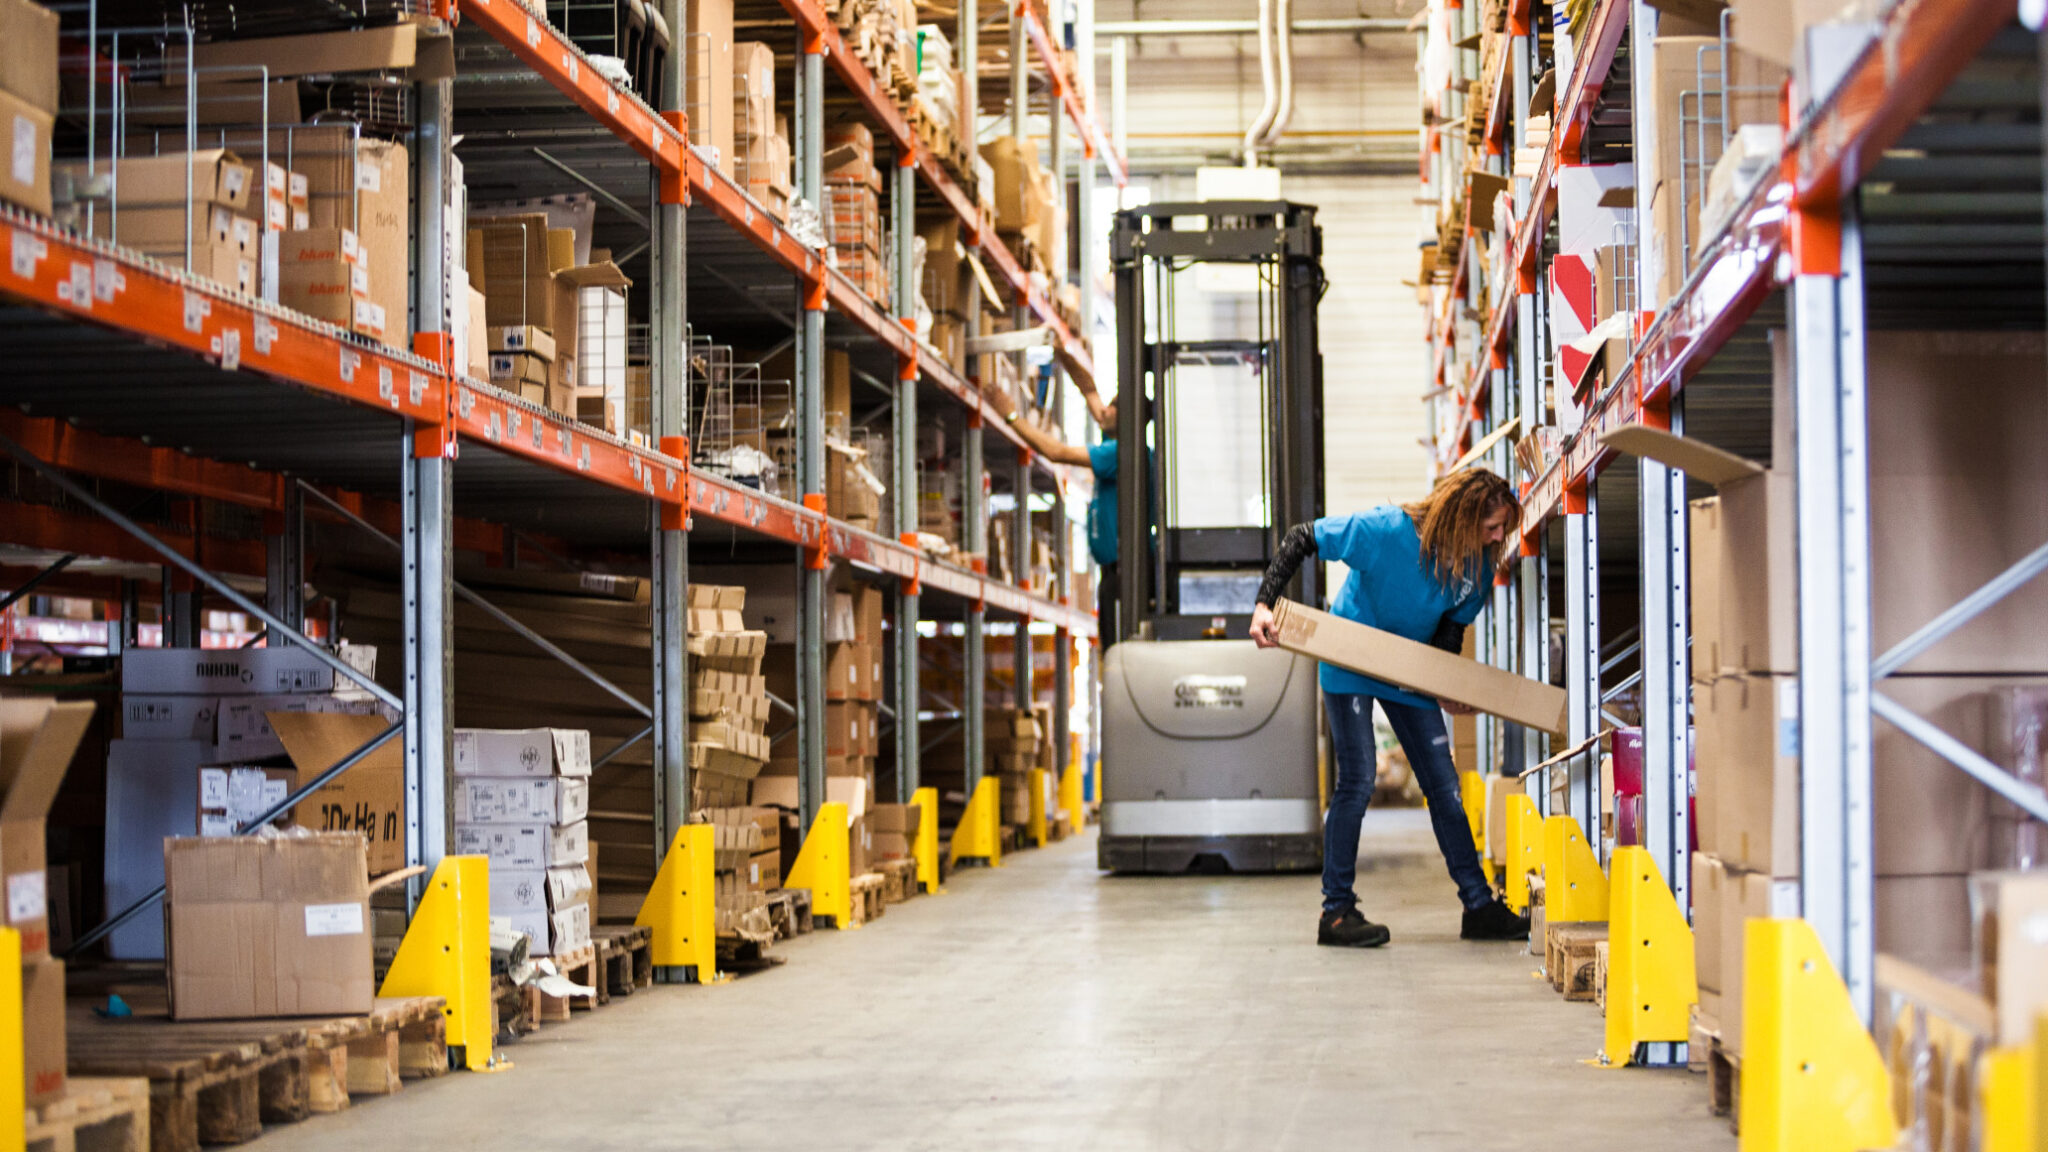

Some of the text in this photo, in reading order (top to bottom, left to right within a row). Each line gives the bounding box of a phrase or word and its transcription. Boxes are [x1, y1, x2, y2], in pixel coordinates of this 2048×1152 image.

[298, 248, 336, 262] blum
[308, 281, 345, 295] blum
[354, 801, 397, 842] Han
